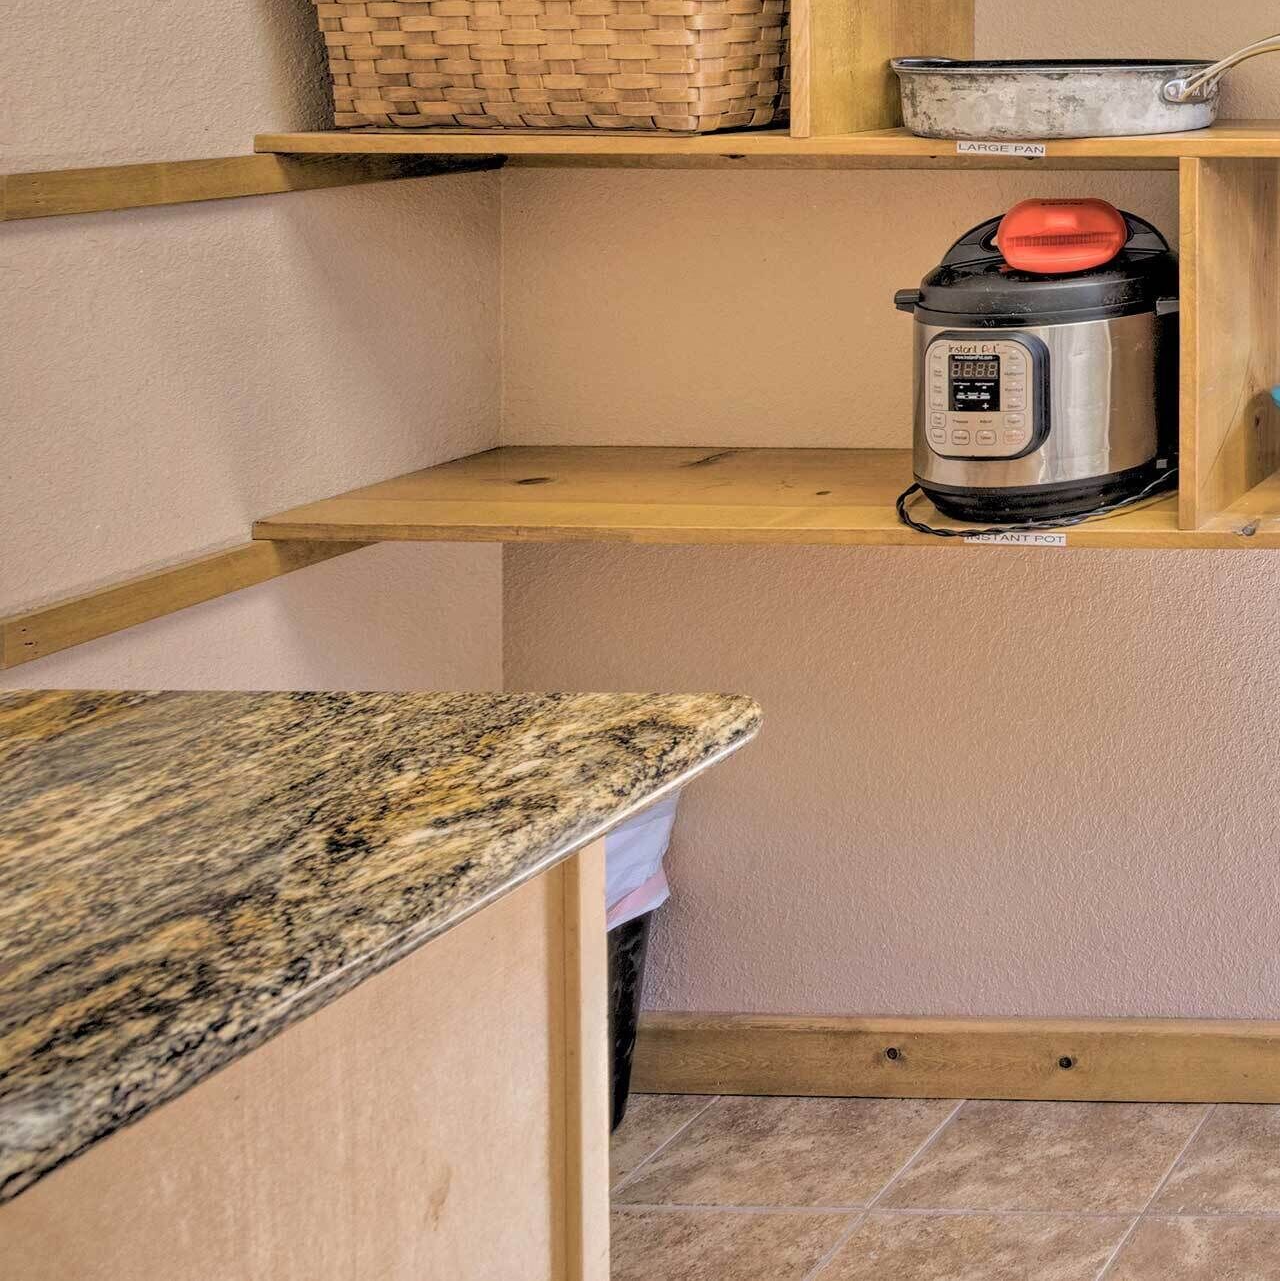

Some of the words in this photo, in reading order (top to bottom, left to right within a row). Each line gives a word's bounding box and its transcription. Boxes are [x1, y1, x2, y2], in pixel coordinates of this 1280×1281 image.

[958, 143, 1009, 152] LARGE
[1014, 145, 1044, 154] PAN
[967, 534, 1031, 542] INSTANT
